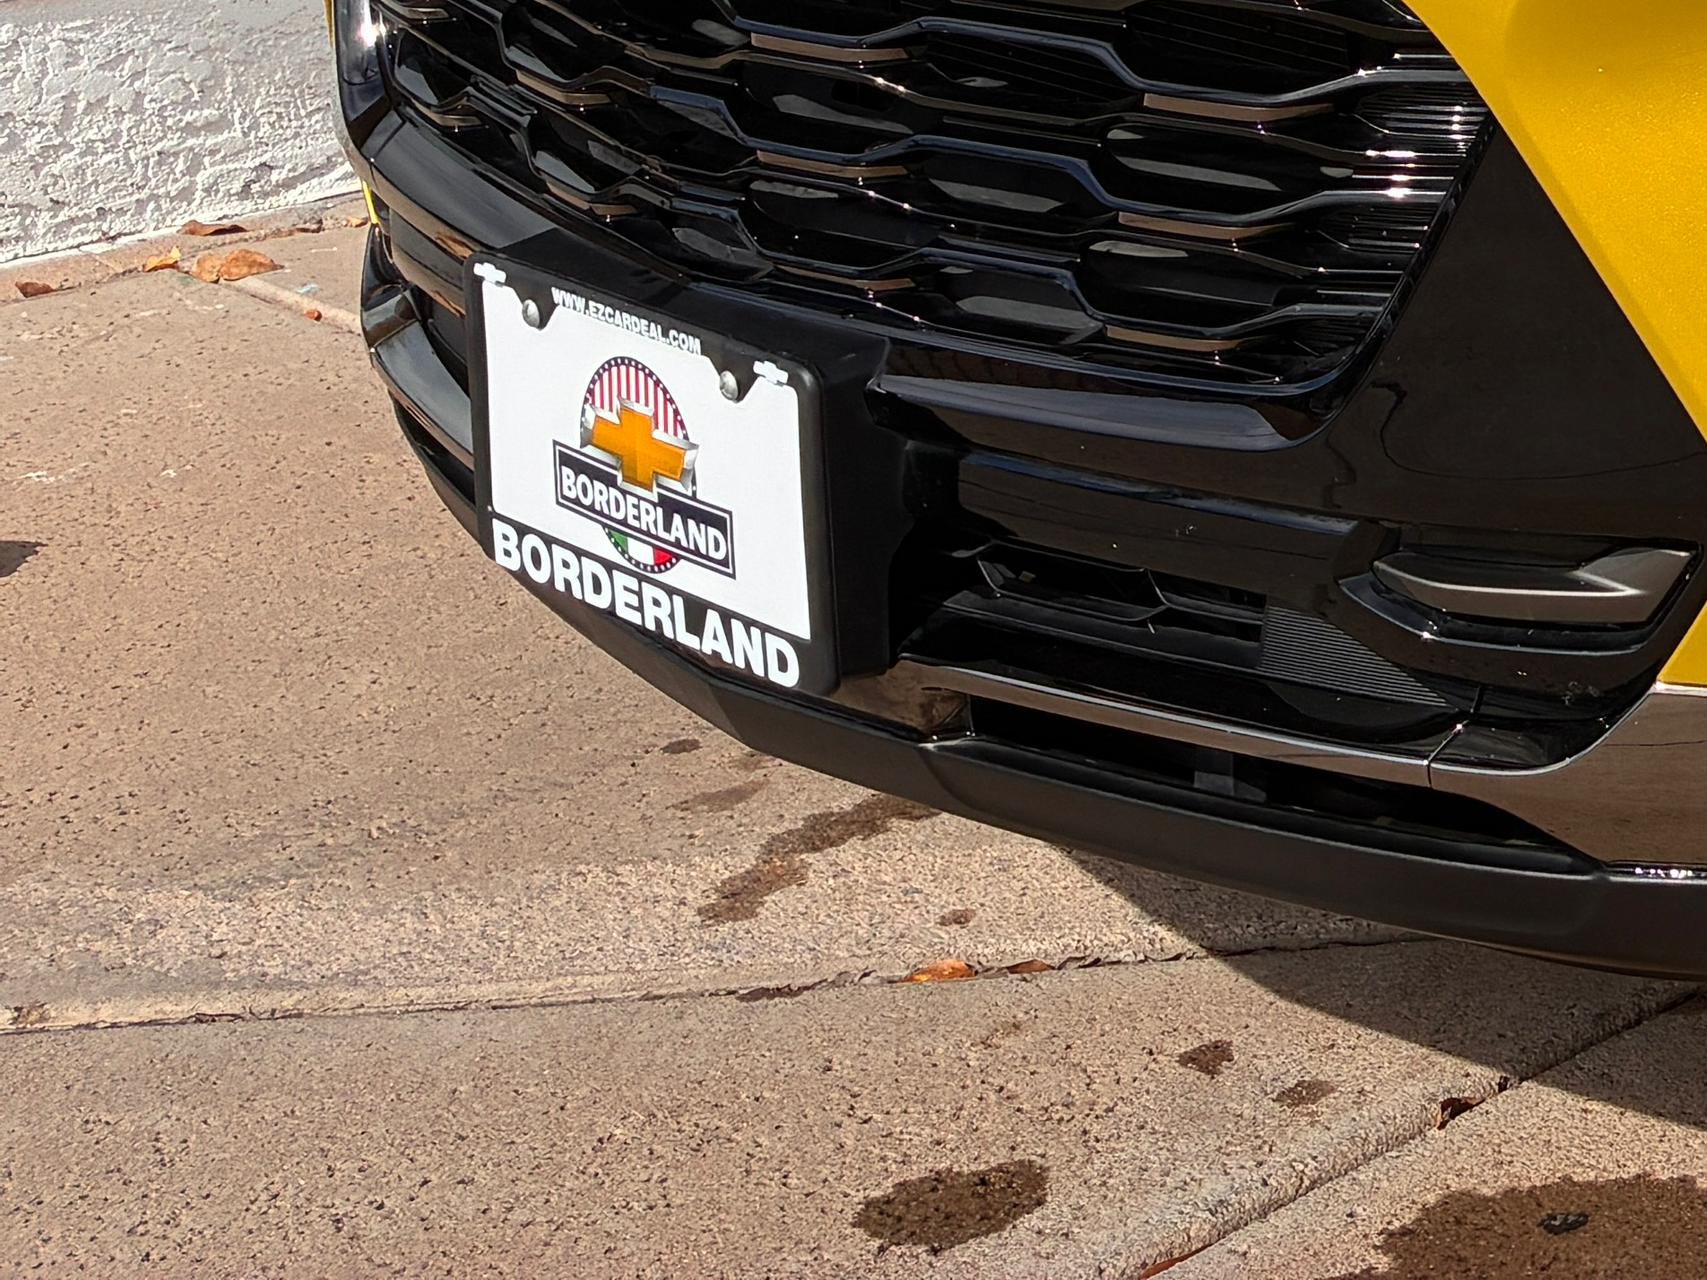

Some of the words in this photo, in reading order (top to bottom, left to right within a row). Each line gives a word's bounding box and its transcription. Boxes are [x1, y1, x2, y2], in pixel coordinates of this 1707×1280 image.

[551, 286, 702, 356] WWW.EZCARDEAL.COM
[561, 463, 727, 562] BORDERLAND
[491, 522, 800, 689] BORDERLAND
